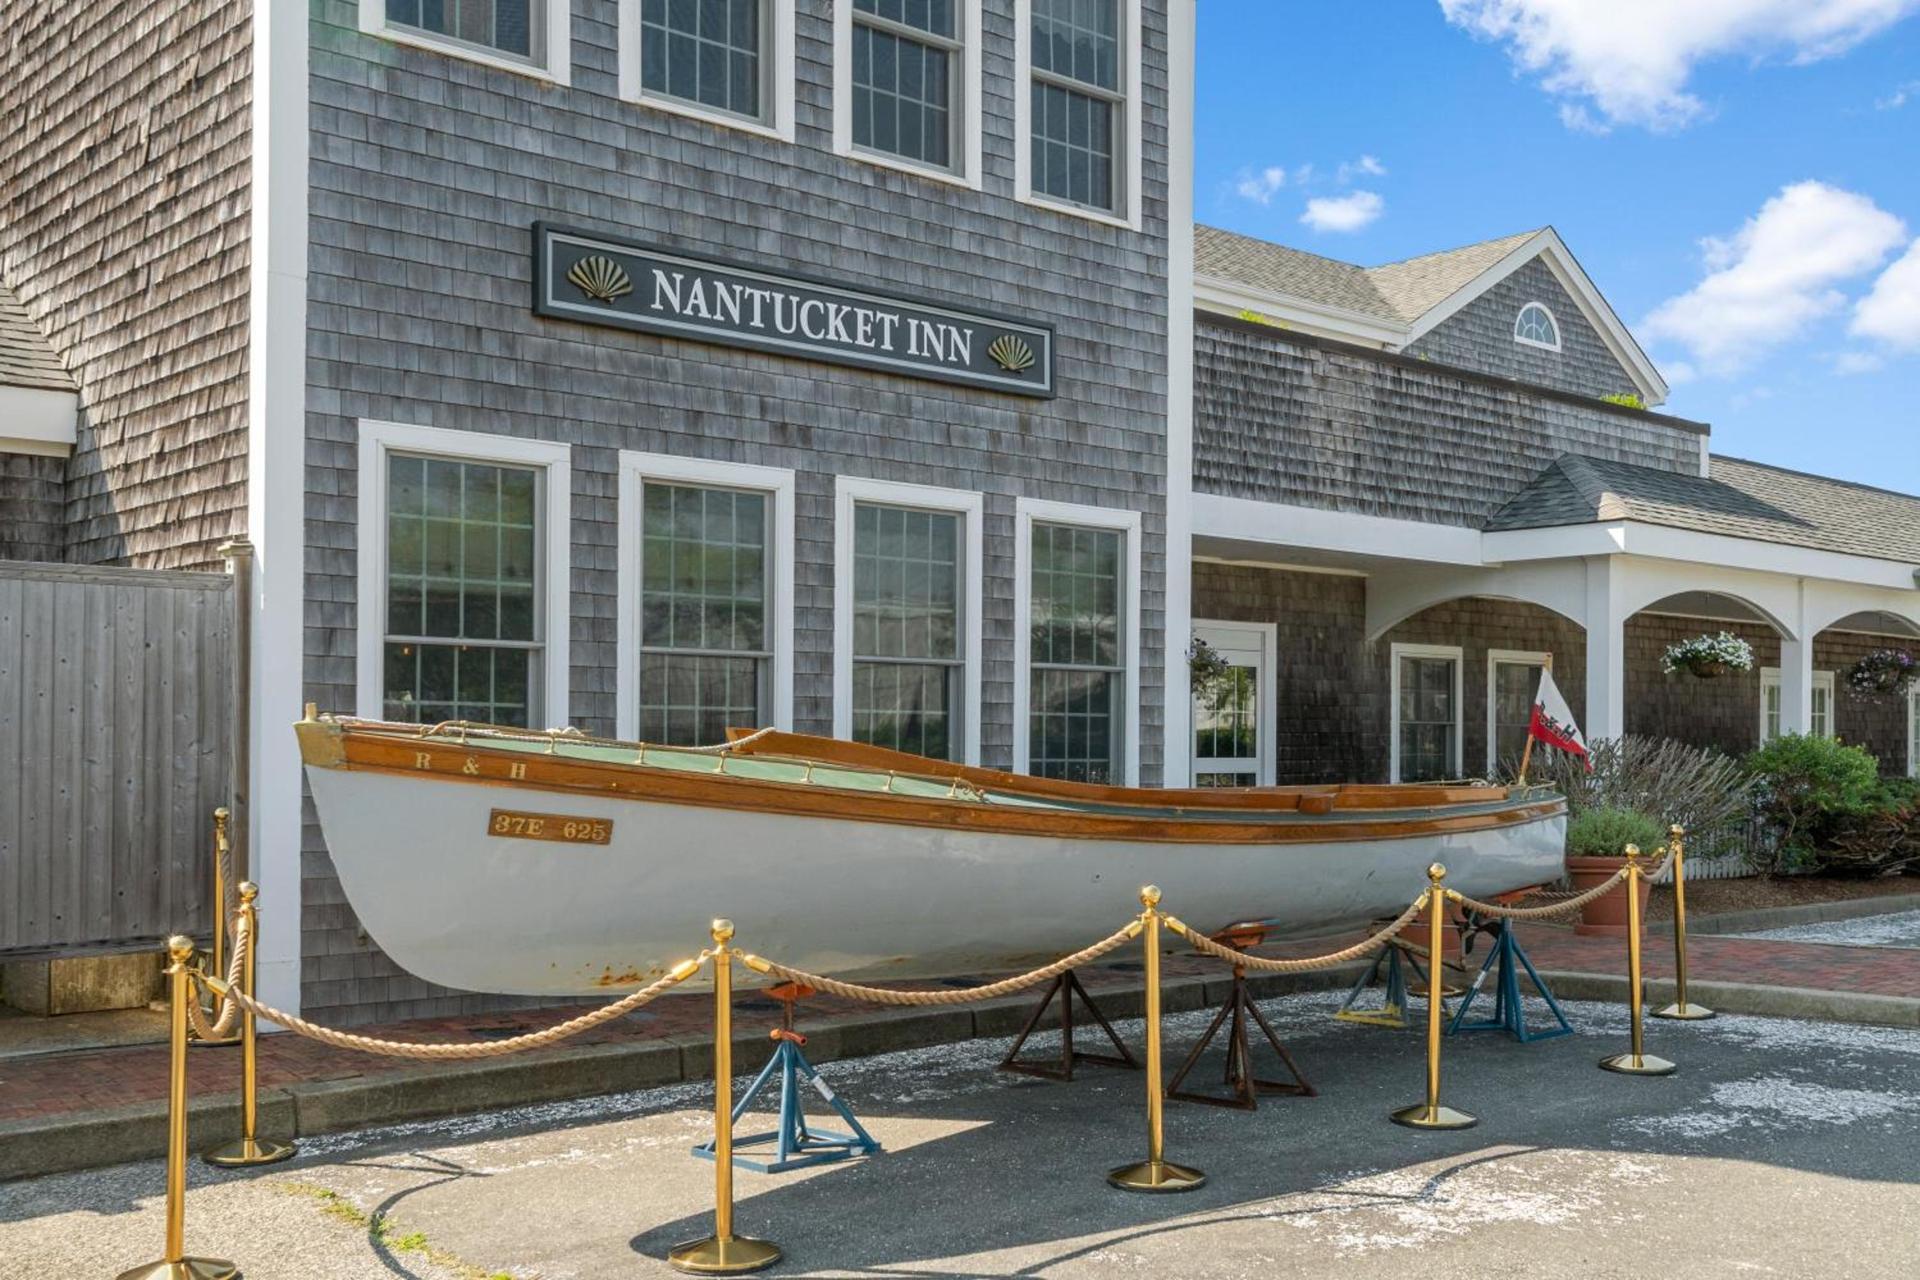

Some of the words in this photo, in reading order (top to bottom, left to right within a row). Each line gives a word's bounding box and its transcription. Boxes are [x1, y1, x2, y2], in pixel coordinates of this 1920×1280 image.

[651, 269, 899, 350] NANTUCKET
[906, 318, 973, 365] INN
[416, 752, 430, 769] R
[463, 757, 479, 775] &
[510, 762, 526, 779] H
[495, 814, 544, 836] 37E
[563, 821, 606, 841] 625
